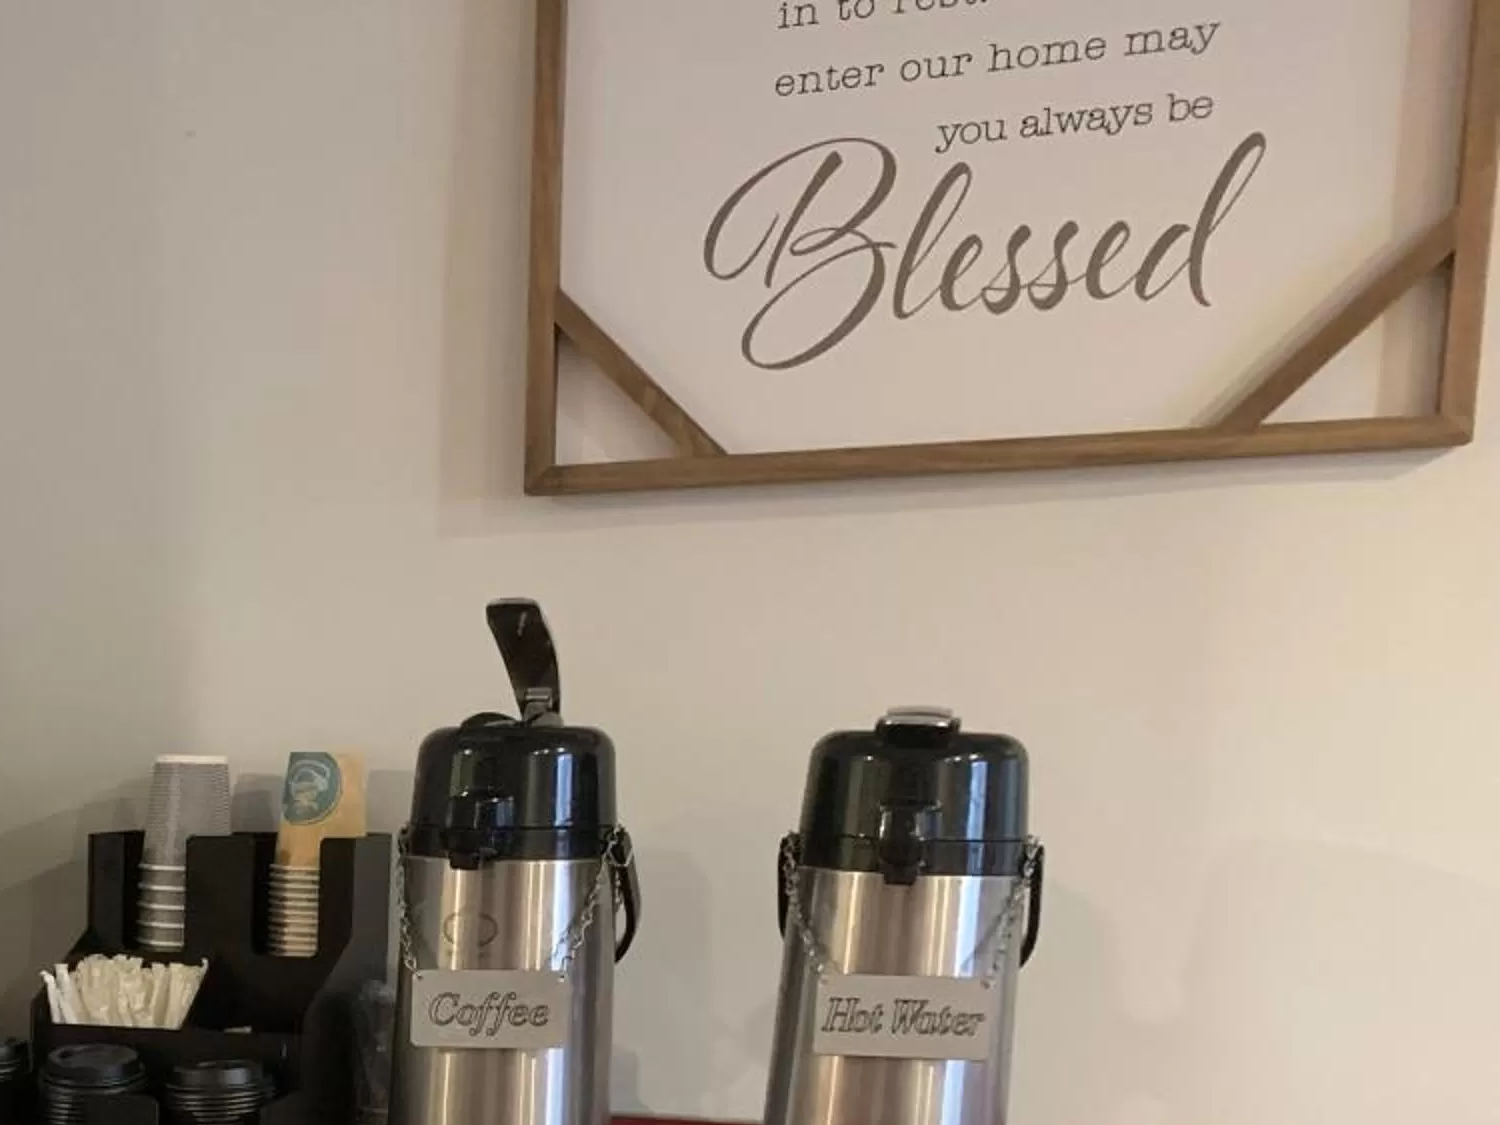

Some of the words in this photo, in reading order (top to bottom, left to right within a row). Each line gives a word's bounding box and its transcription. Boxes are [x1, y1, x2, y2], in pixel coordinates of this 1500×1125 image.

[777, 1, 820, 29] in
[837, 0, 875, 21] to
[775, 63, 885, 97] enter
[900, 52, 973, 82] our
[987, 36, 1107, 73] home
[1123, 21, 1221, 55] may
[934, 118, 1008, 154] you
[1019, 101, 1154, 137] always
[1166, 92, 1214, 123] be
[703, 131, 1267, 370] Blessed
[428, 991, 550, 1037] Coffee
[820, 996, 884, 1034] Hot
[891, 997, 987, 1037] Water
